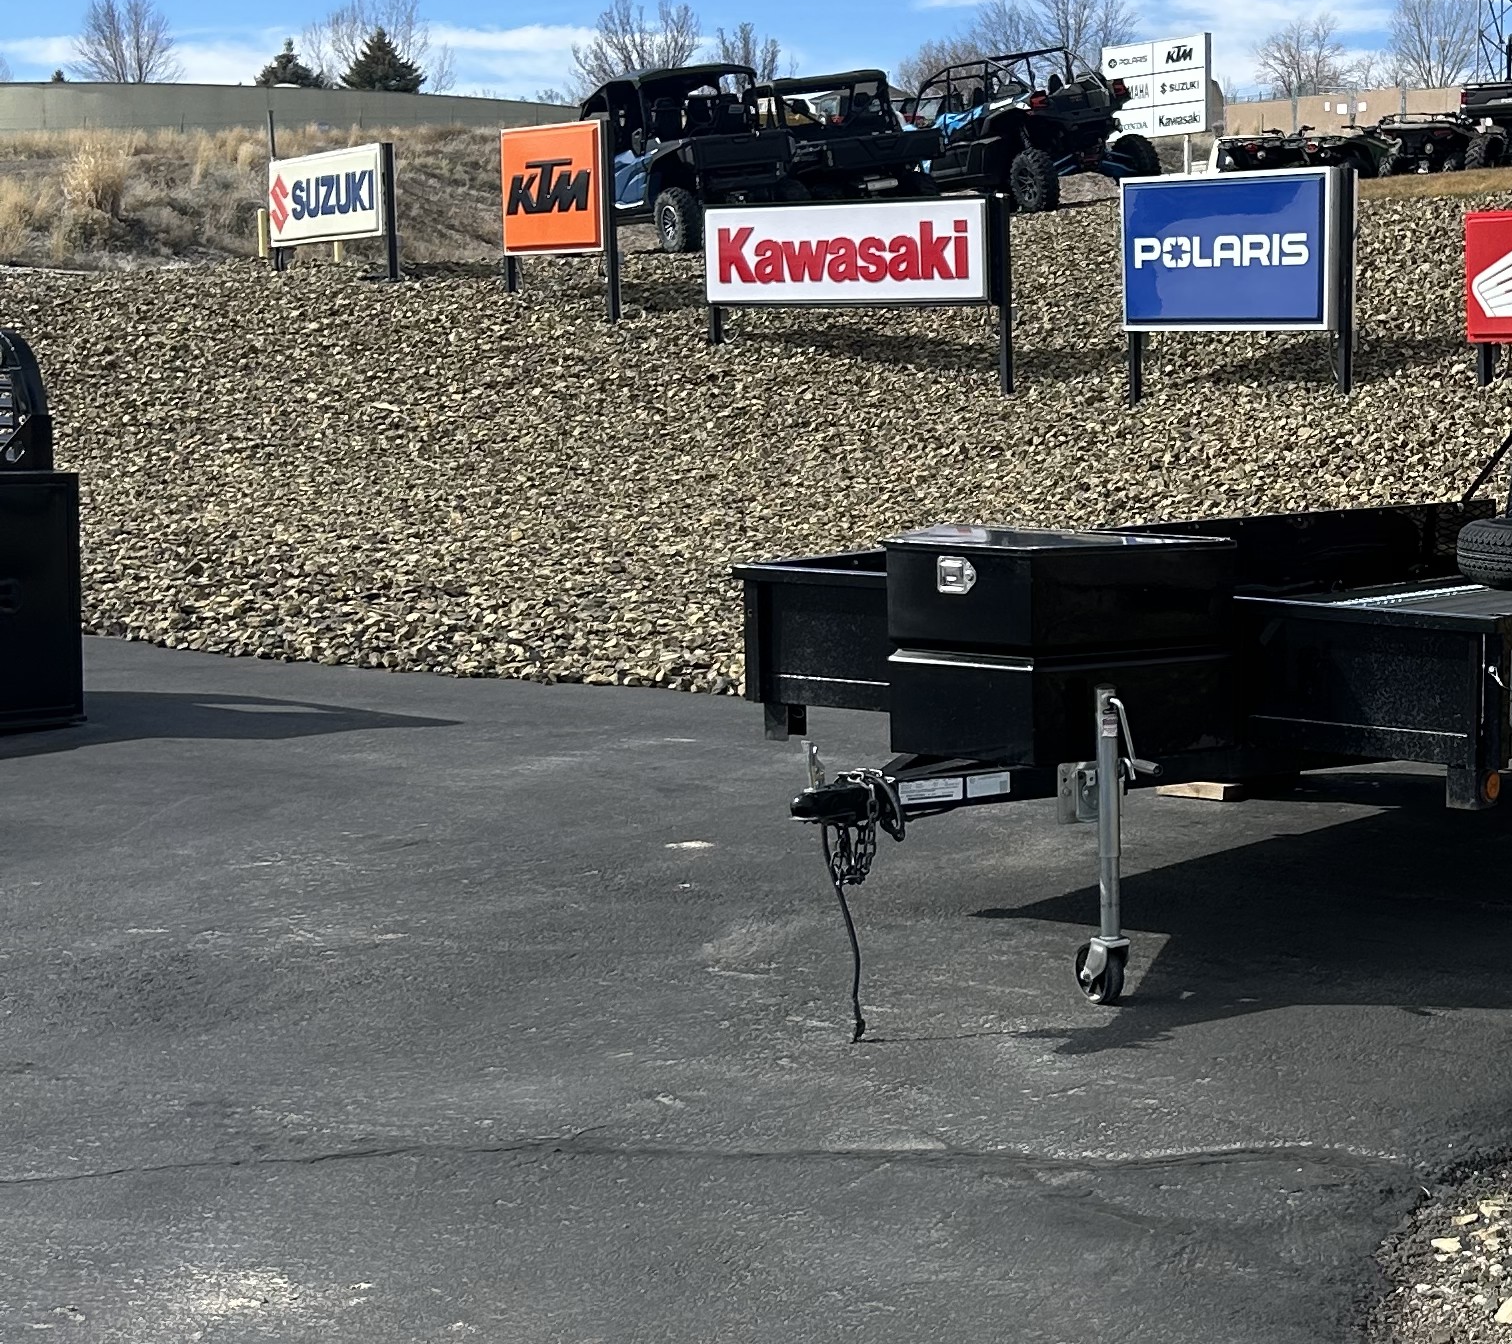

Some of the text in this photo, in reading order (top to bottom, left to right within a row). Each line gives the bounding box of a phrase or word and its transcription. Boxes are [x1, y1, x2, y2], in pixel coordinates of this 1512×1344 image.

[1119, 55, 1148, 65] POLARIS
[1165, 45, 1193, 64] KTM
[1127, 83, 1149, 99] MAHA
[1169, 80, 1199, 92] SUZUKI
[1121, 121, 1148, 131] ONDA
[1158, 111, 1200, 127] Kawasaki
[291, 169, 374, 221] SUZUKI
[506, 158, 591, 215] KTM
[717, 220, 970, 284] Kawasaki
[1133, 233, 1309, 269] POLARIS
